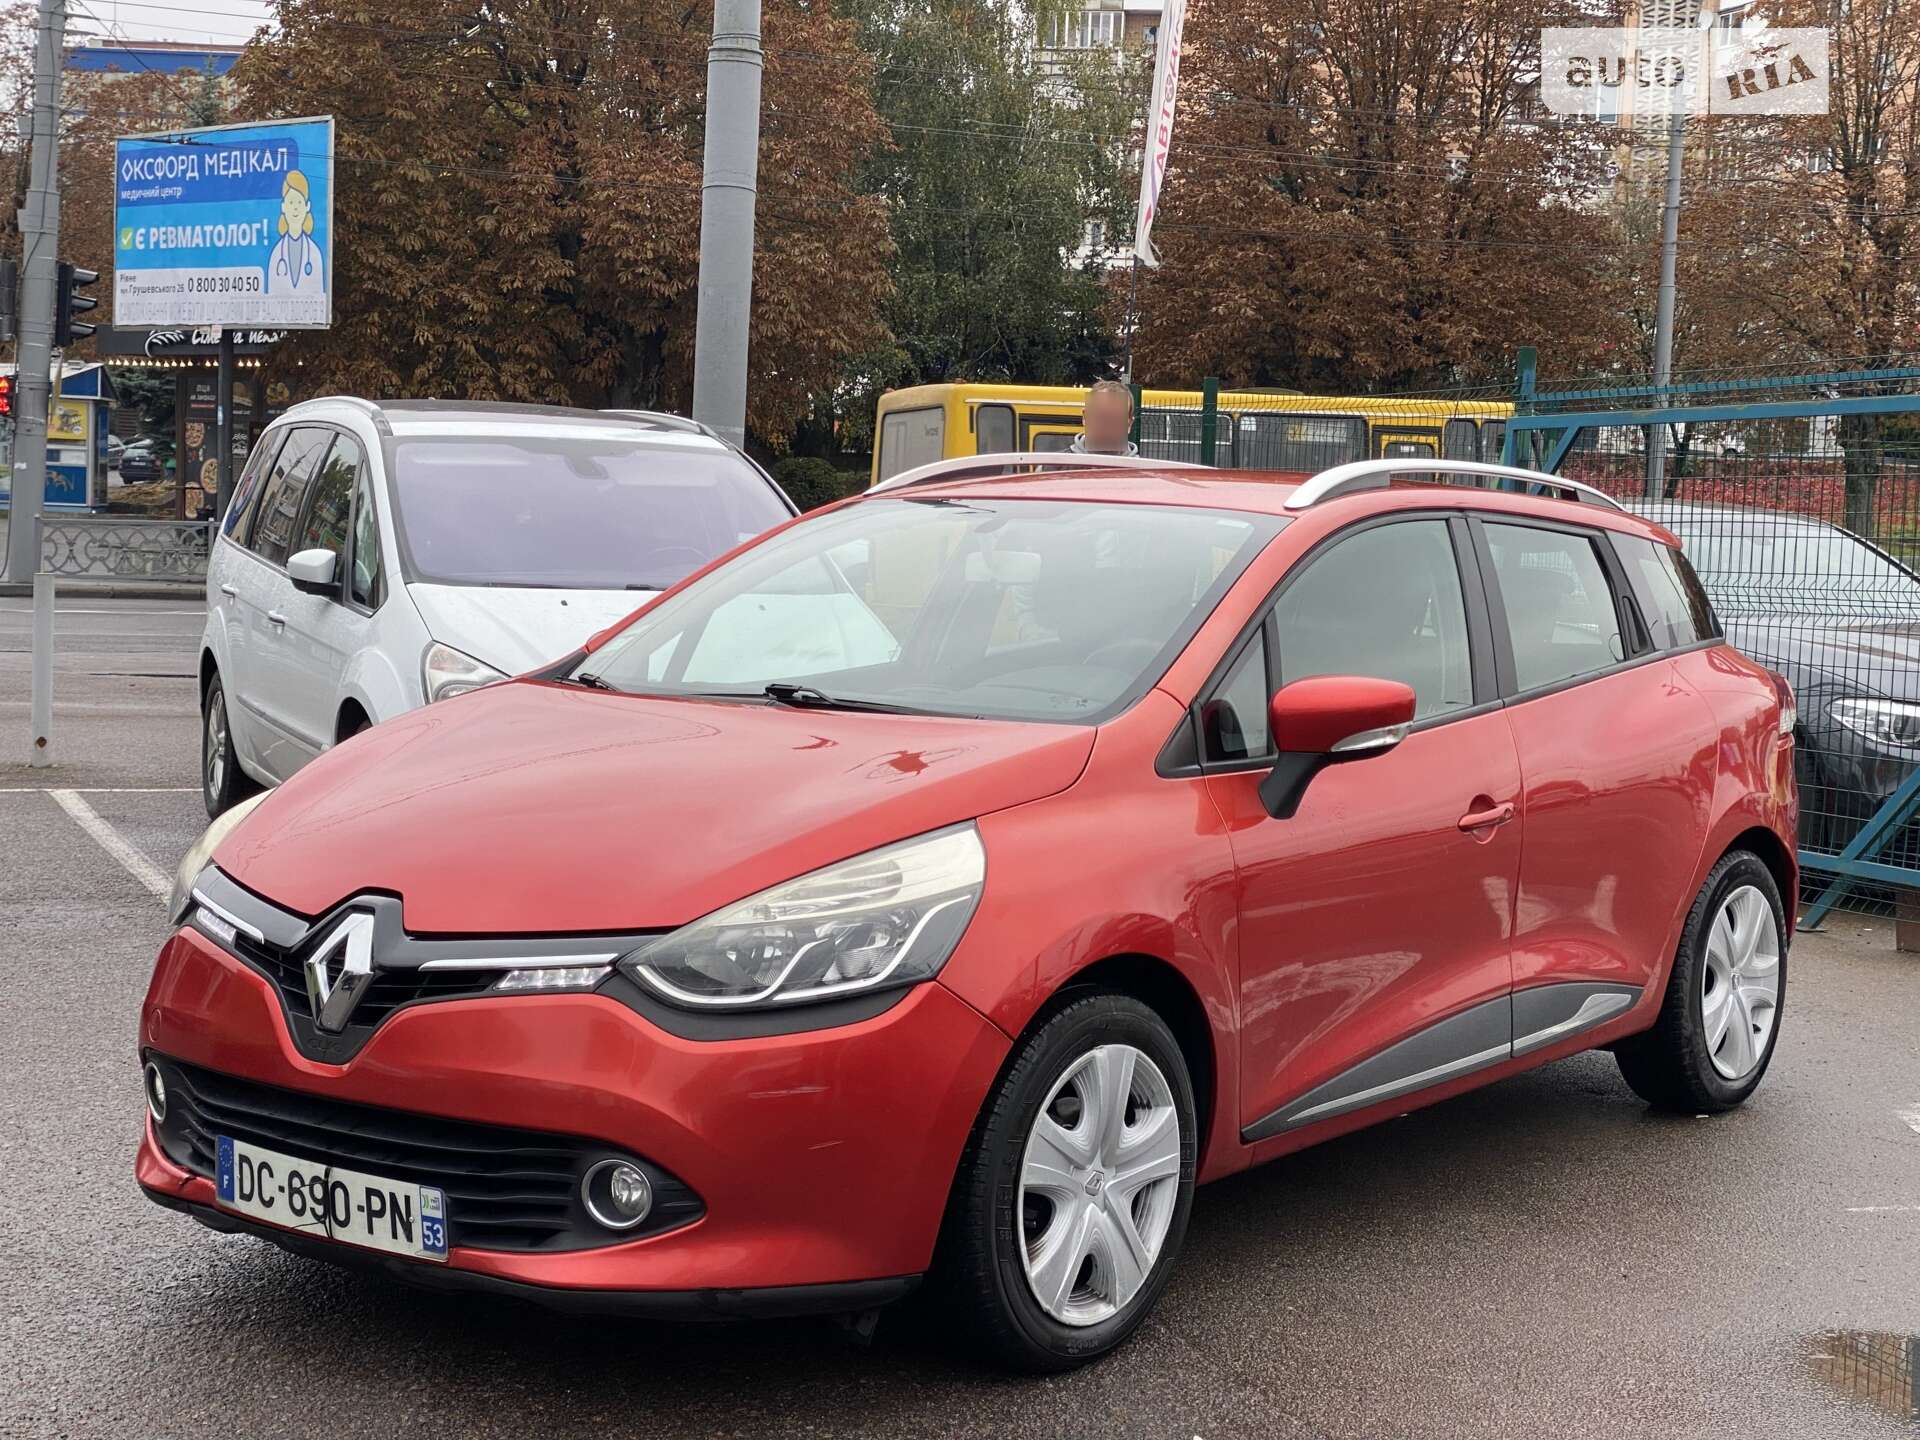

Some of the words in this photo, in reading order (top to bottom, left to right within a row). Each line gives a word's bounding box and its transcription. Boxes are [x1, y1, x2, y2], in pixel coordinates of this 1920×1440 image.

[121, 154, 199, 182] ОКСФОРД
[205, 148, 288, 178] МЕДІКАЛ
[120, 187, 160, 201] медичний
[159, 185, 183, 199] центр
[135, 228, 146, 250] Є
[149, 219, 269, 249] РЕВМАТОЛОГ!
[187, 278, 194, 293] 0
[196, 276, 217, 293] 800
[218, 276, 230, 293] 30
[231, 276, 244, 292] 40
[245, 275, 260, 292] 50
[223, 1176, 229, 1189] F
[238, 1153, 414, 1243] DC-690-PN
[423, 1221, 444, 1248] 53
